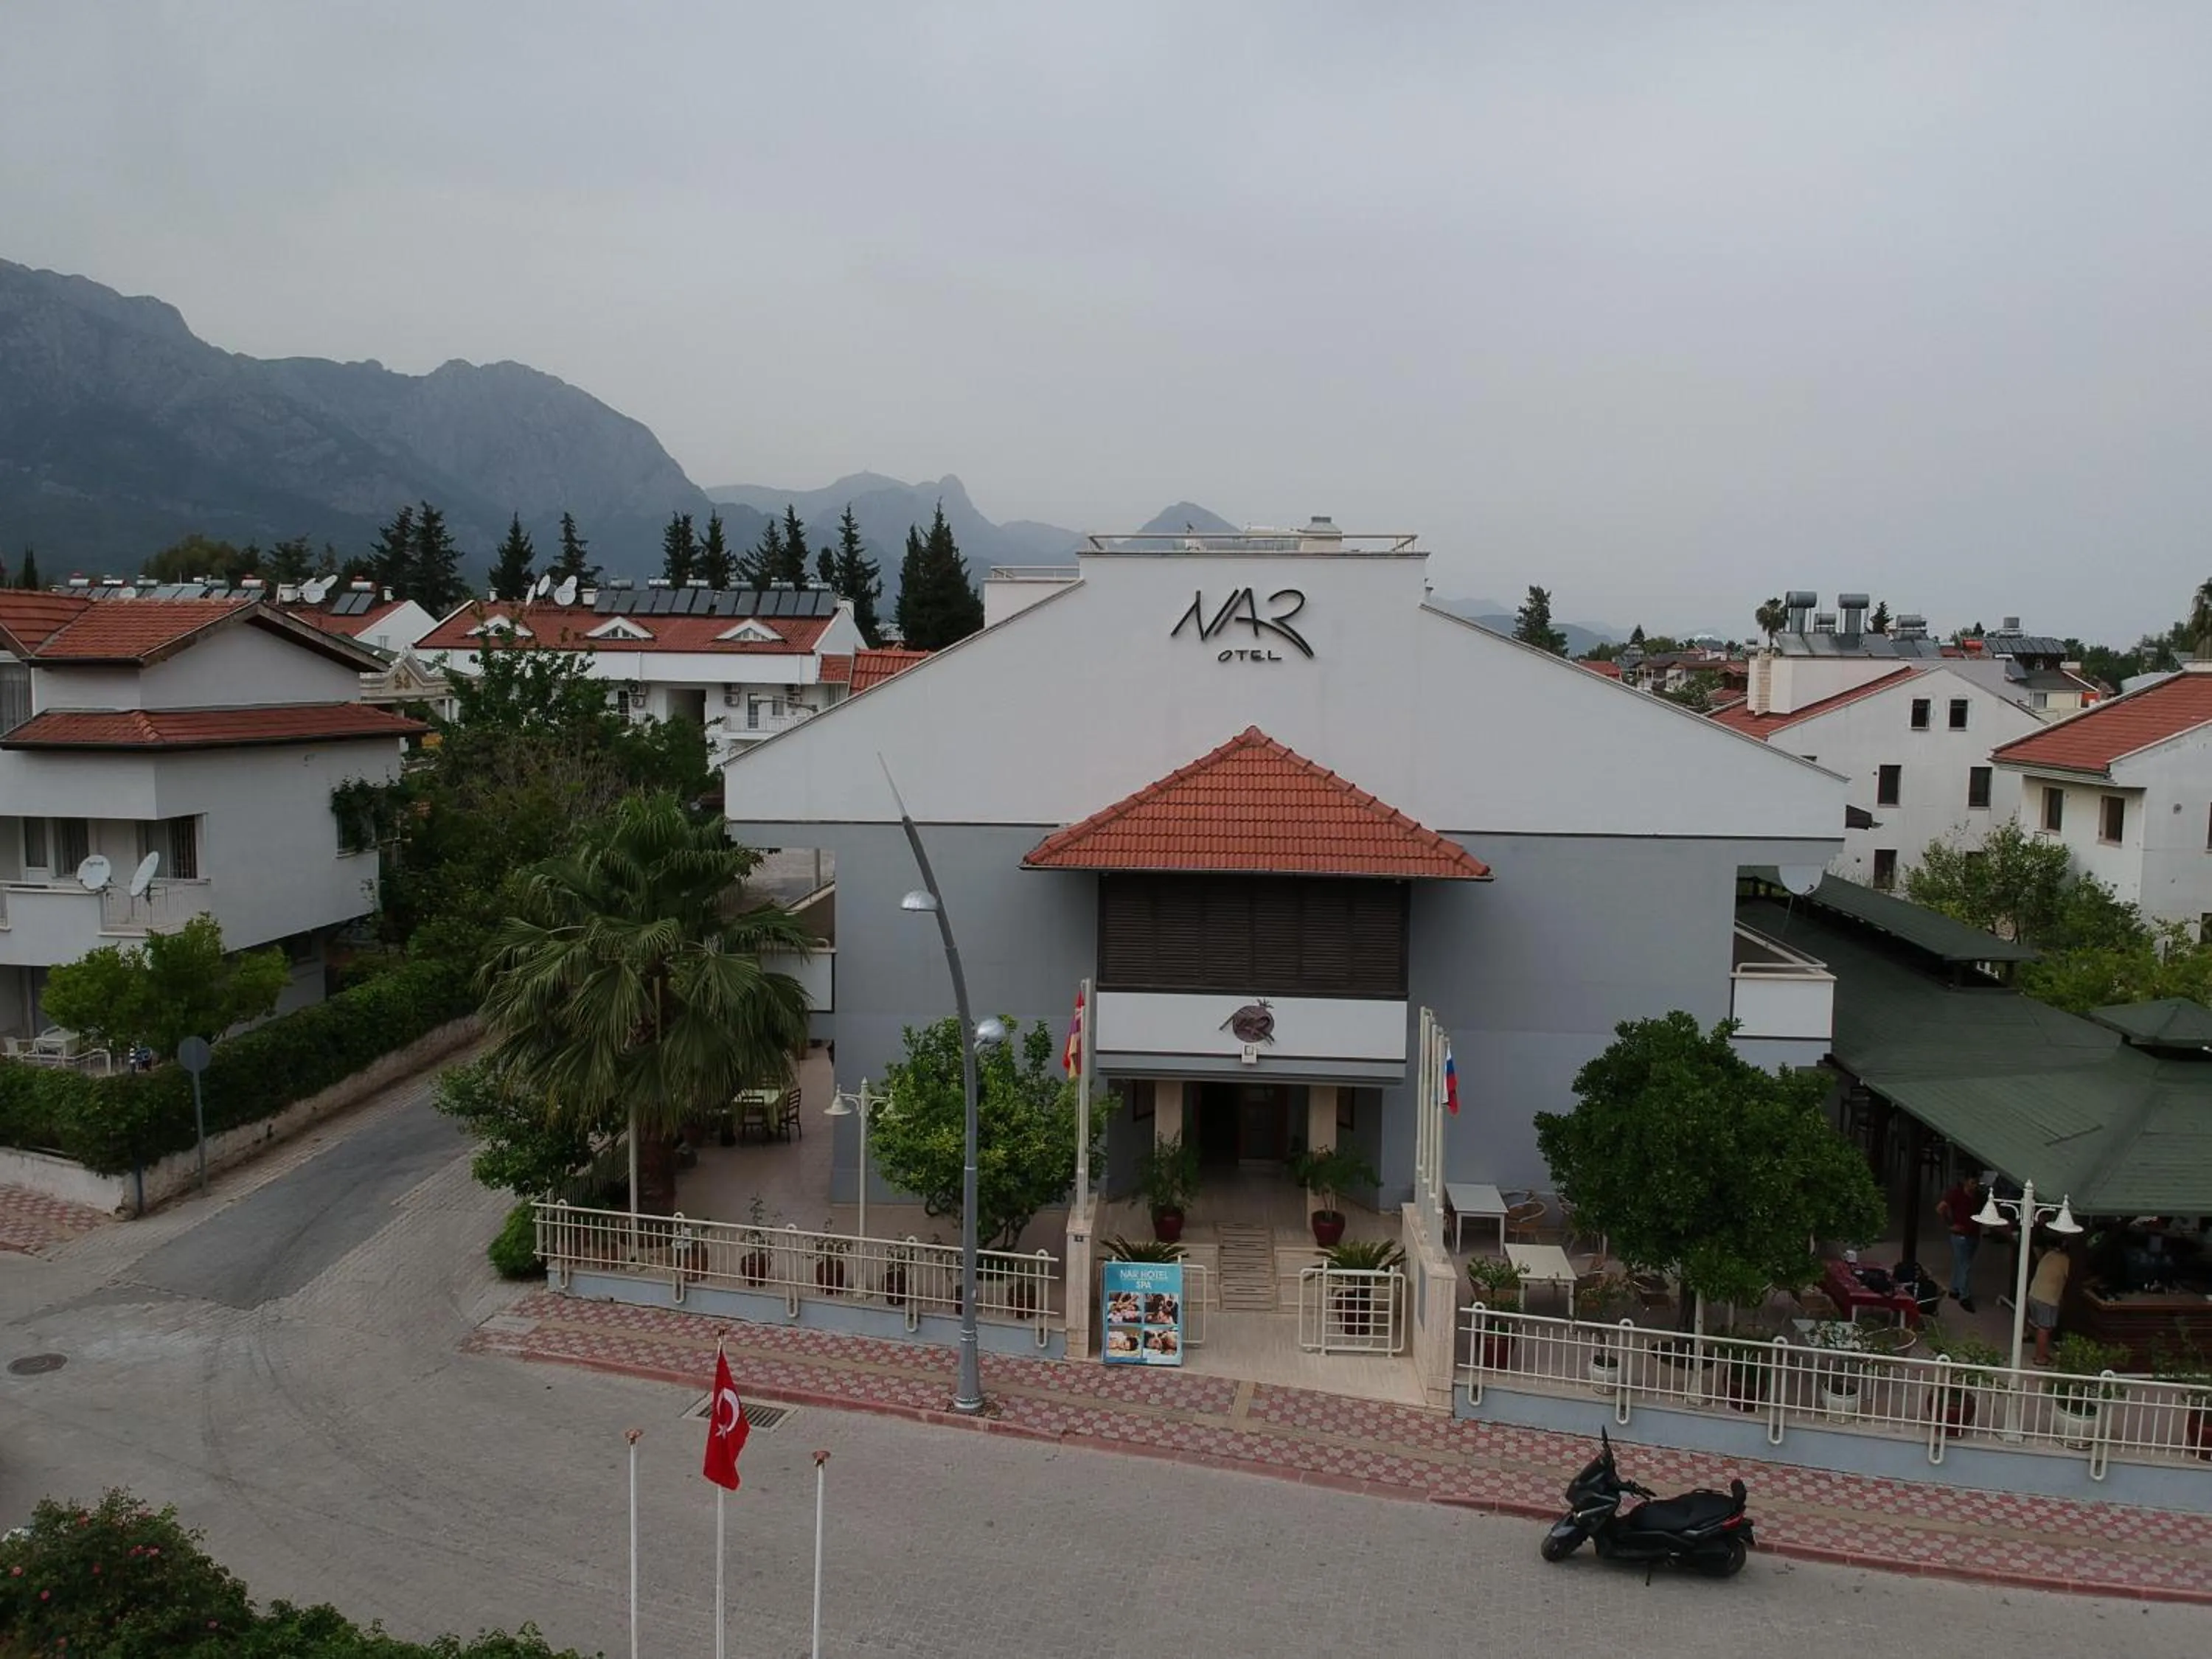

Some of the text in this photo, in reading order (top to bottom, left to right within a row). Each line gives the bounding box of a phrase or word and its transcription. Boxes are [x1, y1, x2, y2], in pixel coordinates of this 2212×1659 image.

[1170, 587, 1314, 660] NAR
[1217, 649, 1282, 661] OTEL
[1141, 1270, 1169, 1280] HOTEL
[1135, 1280, 1152, 1290] SPA
